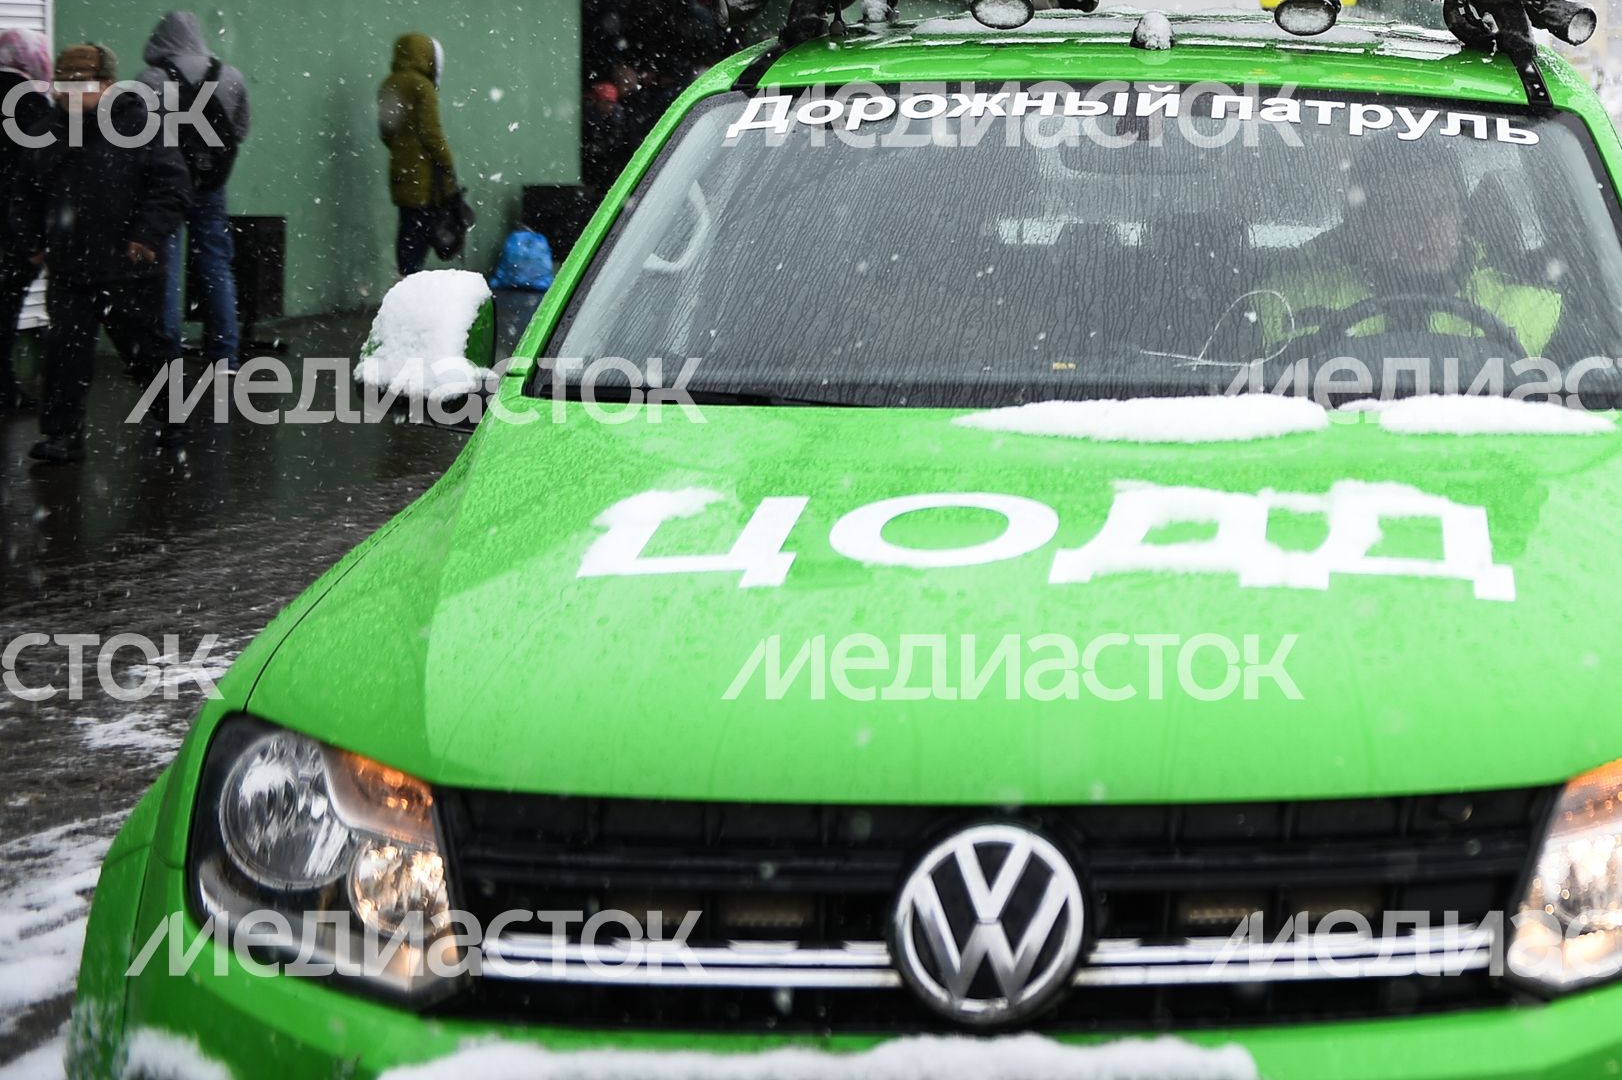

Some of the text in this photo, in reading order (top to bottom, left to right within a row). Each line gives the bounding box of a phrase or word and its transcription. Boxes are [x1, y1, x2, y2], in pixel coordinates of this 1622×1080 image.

[726, 83, 1541, 146] Дорожный патруль
[576, 480, 1515, 601] ЦОДД
